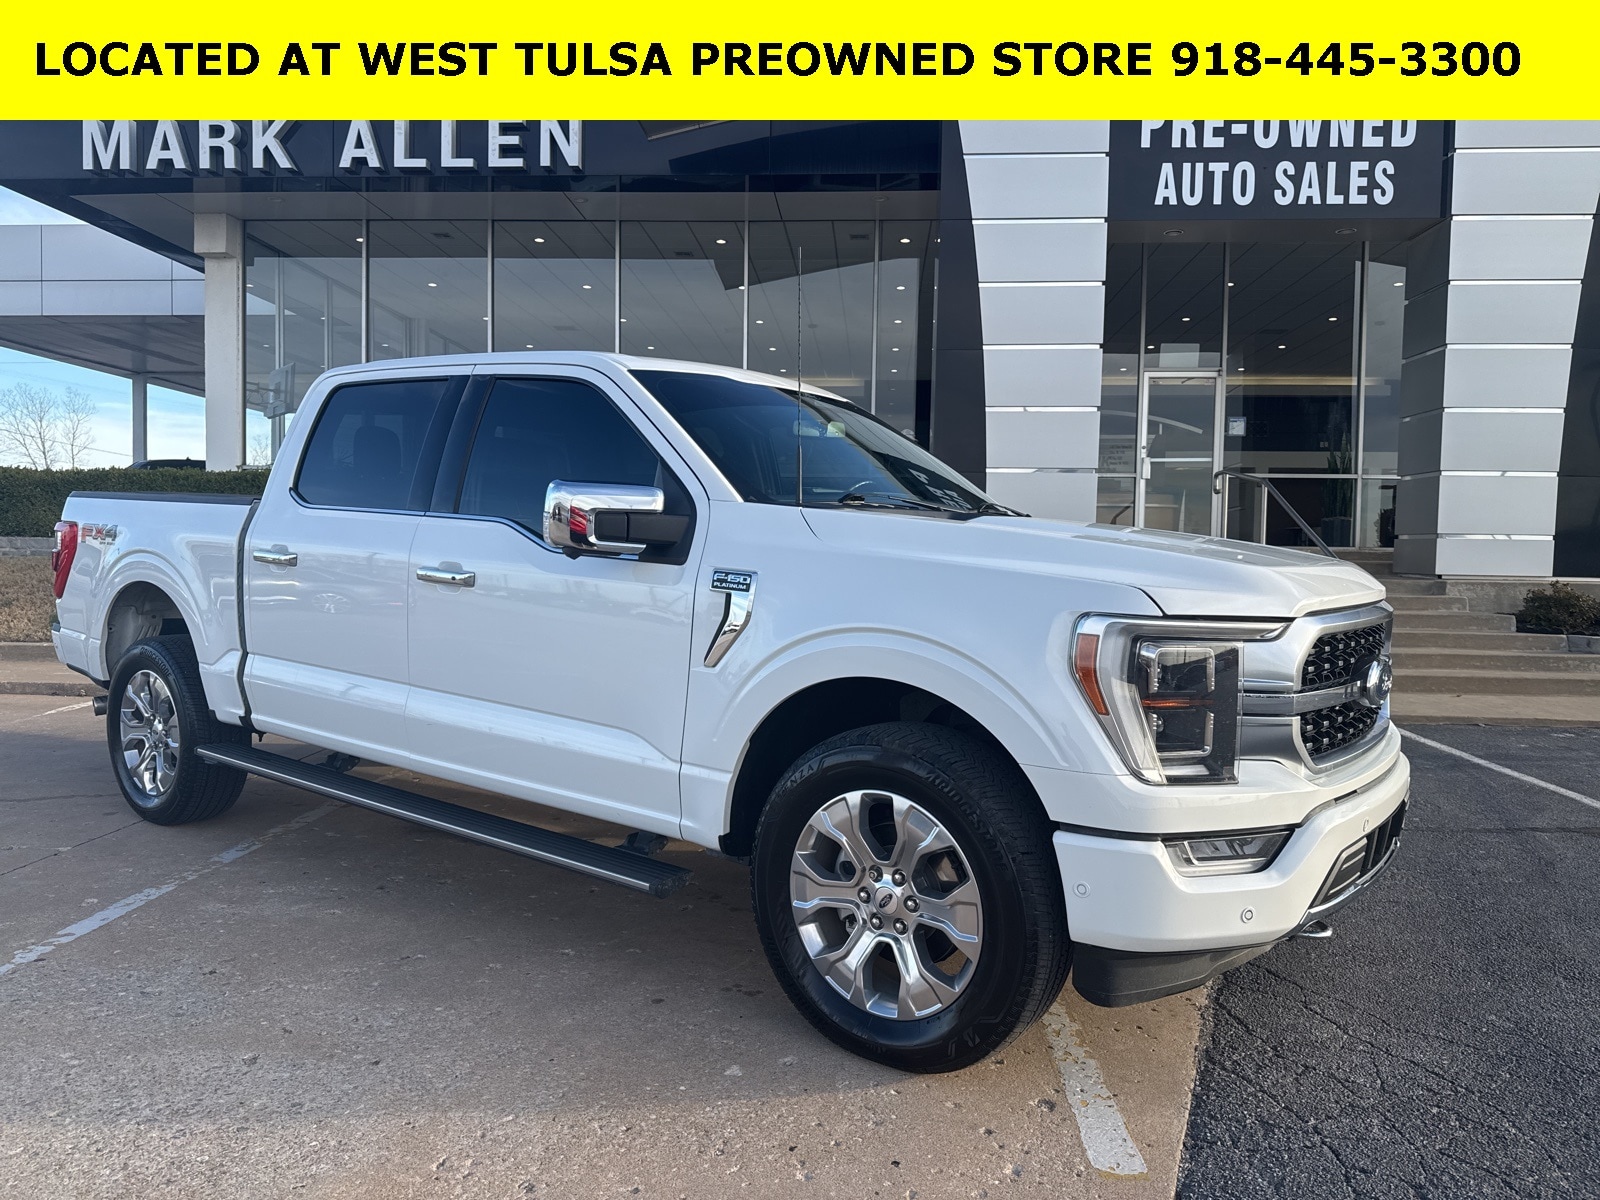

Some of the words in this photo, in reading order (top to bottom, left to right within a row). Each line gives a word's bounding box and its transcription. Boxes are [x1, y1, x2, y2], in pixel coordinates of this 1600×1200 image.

[82, 120, 298, 172] MARK
[339, 120, 582, 170] ALLEN
[1140, 120, 1418, 149] PRE-OWNED
[1154, 161, 1256, 207] AUTO
[1274, 160, 1396, 206] SALES
[81, 523, 118, 543] FX4
[713, 573, 751, 585] F-150
[713, 582, 747, 590] PLATINUM
